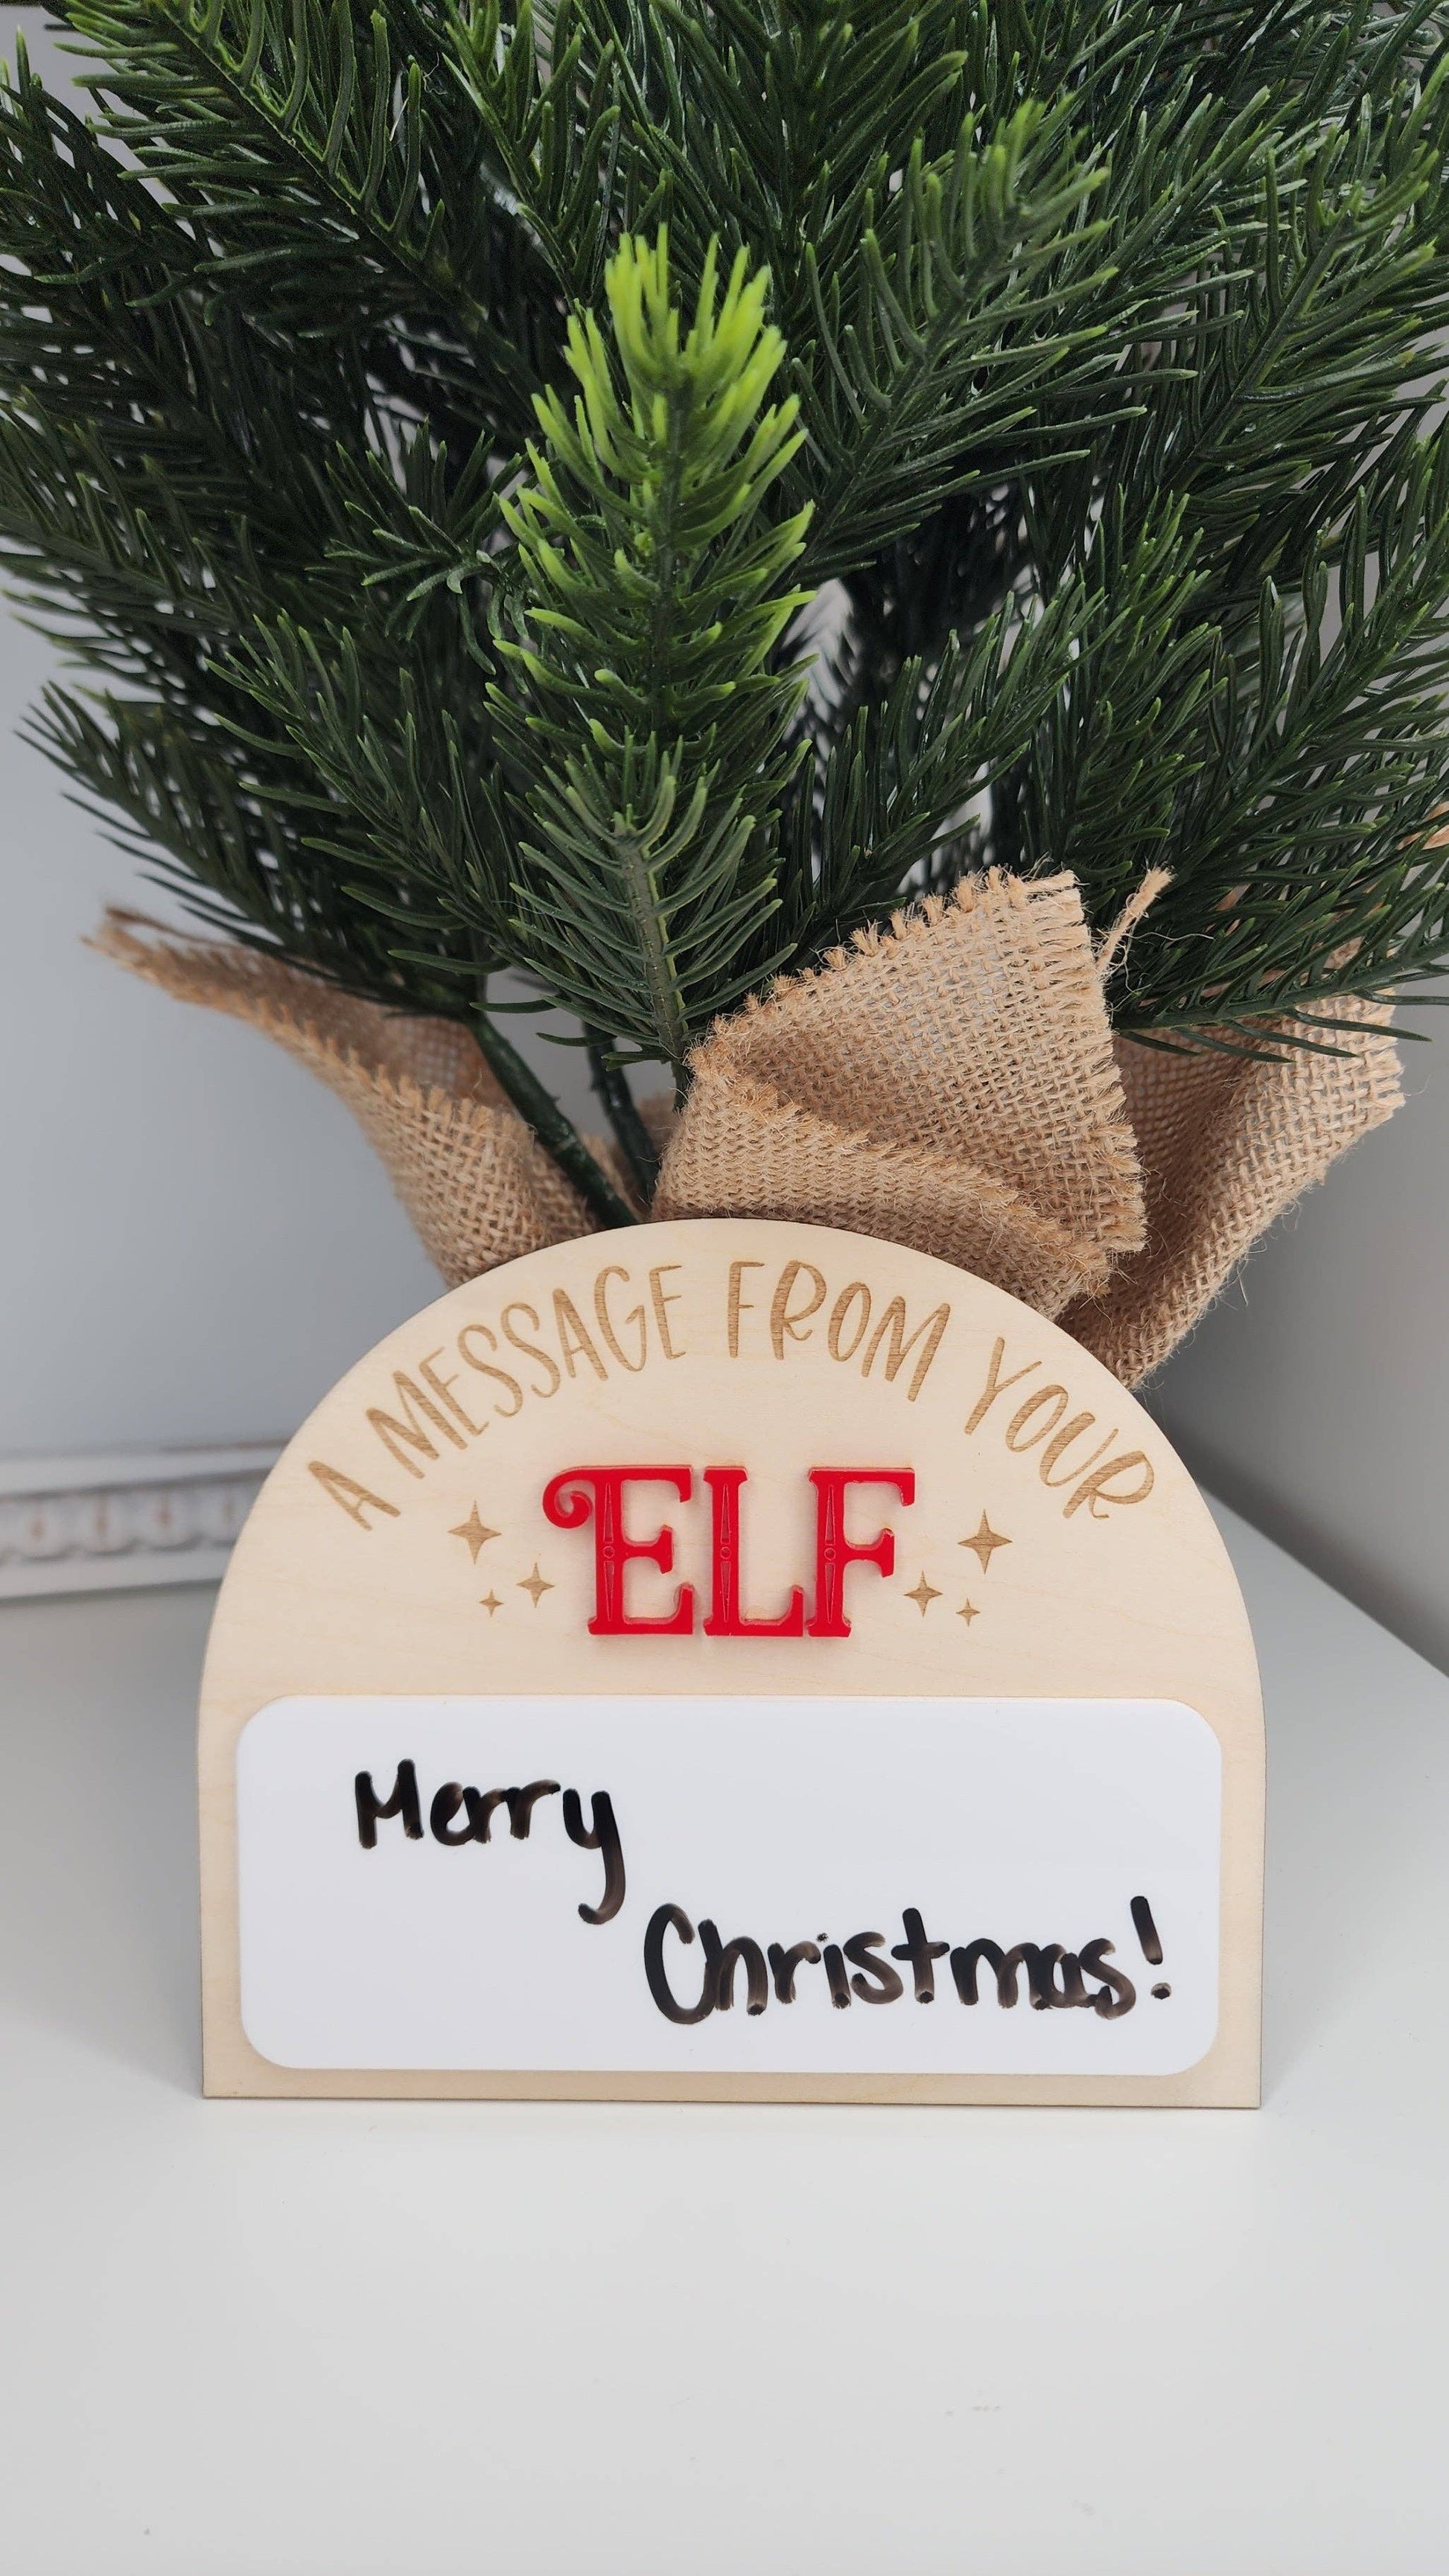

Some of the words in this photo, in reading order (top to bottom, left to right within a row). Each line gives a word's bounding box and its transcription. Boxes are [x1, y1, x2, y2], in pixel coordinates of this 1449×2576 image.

[307, 1459, 402, 1531] A
[365, 1264, 687, 1479] MESSAGE
[727, 1259, 952, 1402] FROM
[964, 1336, 1156, 1520] YOUR
[542, 1464, 916, 1638] ELF
[354, 1758, 627, 1925] Merry
[643, 1895, 1173, 2025] Christmas!
